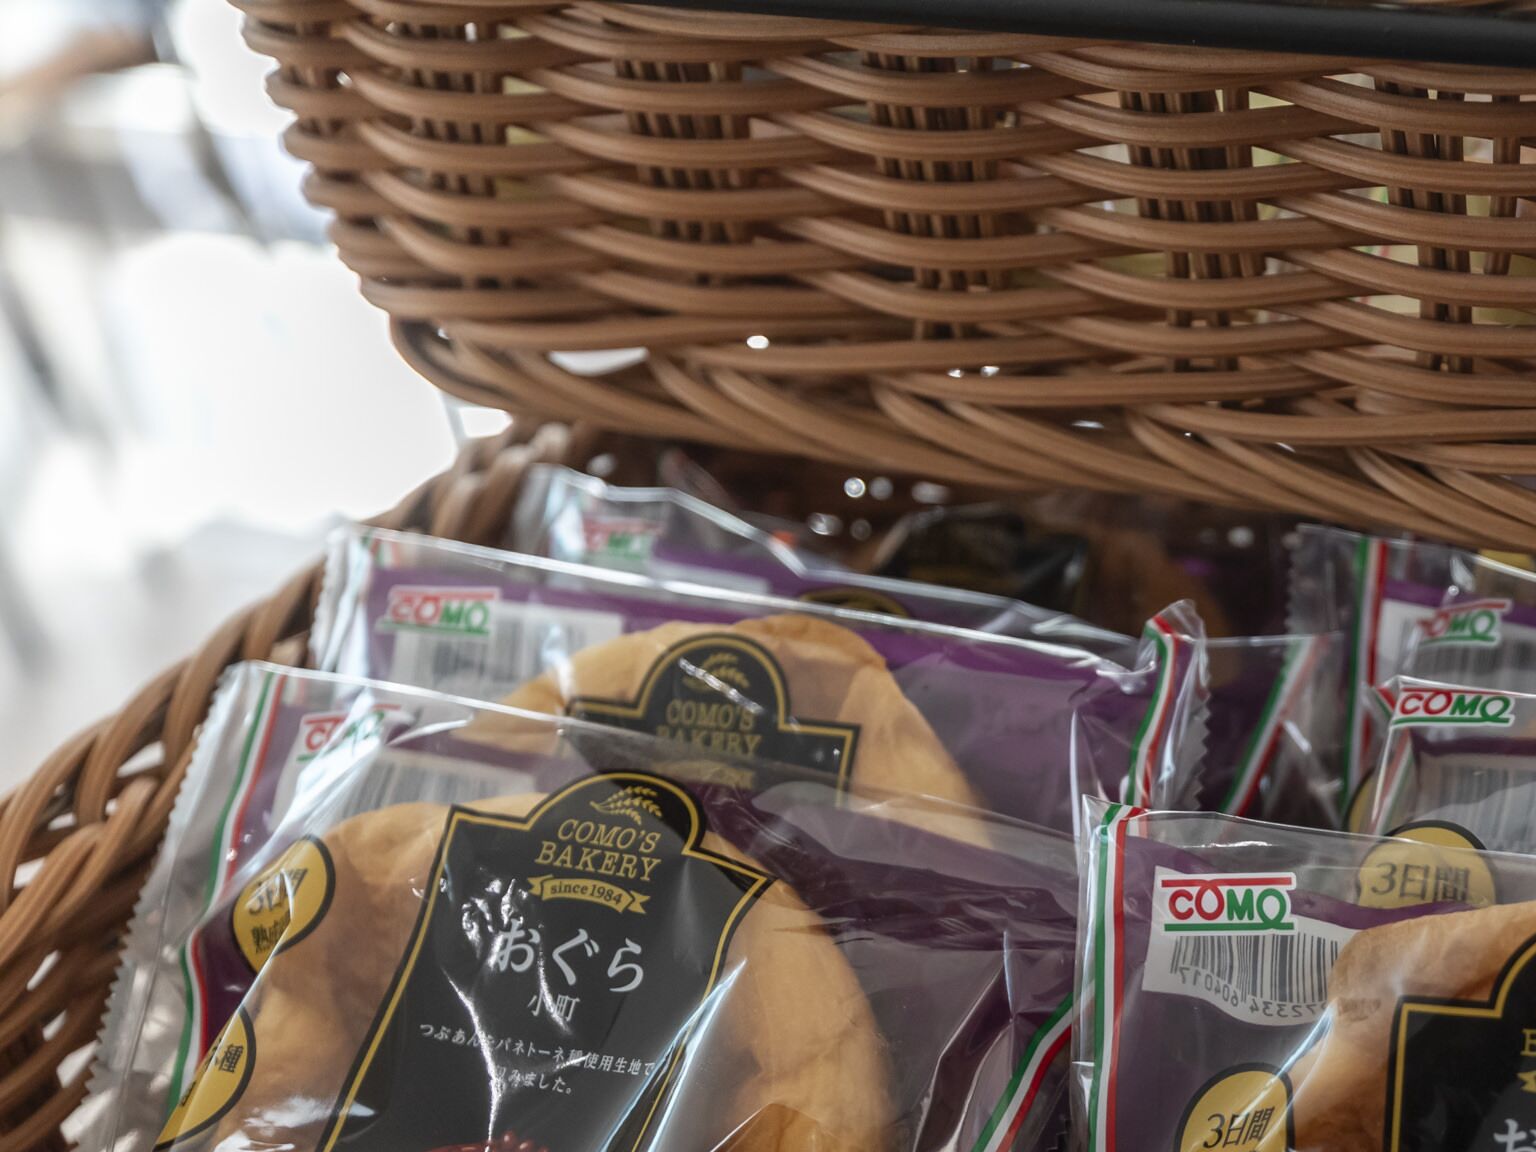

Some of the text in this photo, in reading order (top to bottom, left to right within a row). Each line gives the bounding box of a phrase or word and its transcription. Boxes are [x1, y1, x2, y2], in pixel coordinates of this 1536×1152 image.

[391, 591, 494, 635] COMO
[1393, 688, 1512, 724] COMO
[558, 819, 661, 853] COMO'S
[534, 840, 662, 882] BAKERY
[1370, 861, 1470, 902] 3日間
[550, 880, 623, 904] since 1984
[1162, 879, 1293, 930] COMO
[490, 918, 645, 993] おぐら
[527, 992, 581, 1022] 小町
[1203, 1105, 1276, 1150] 3日間
